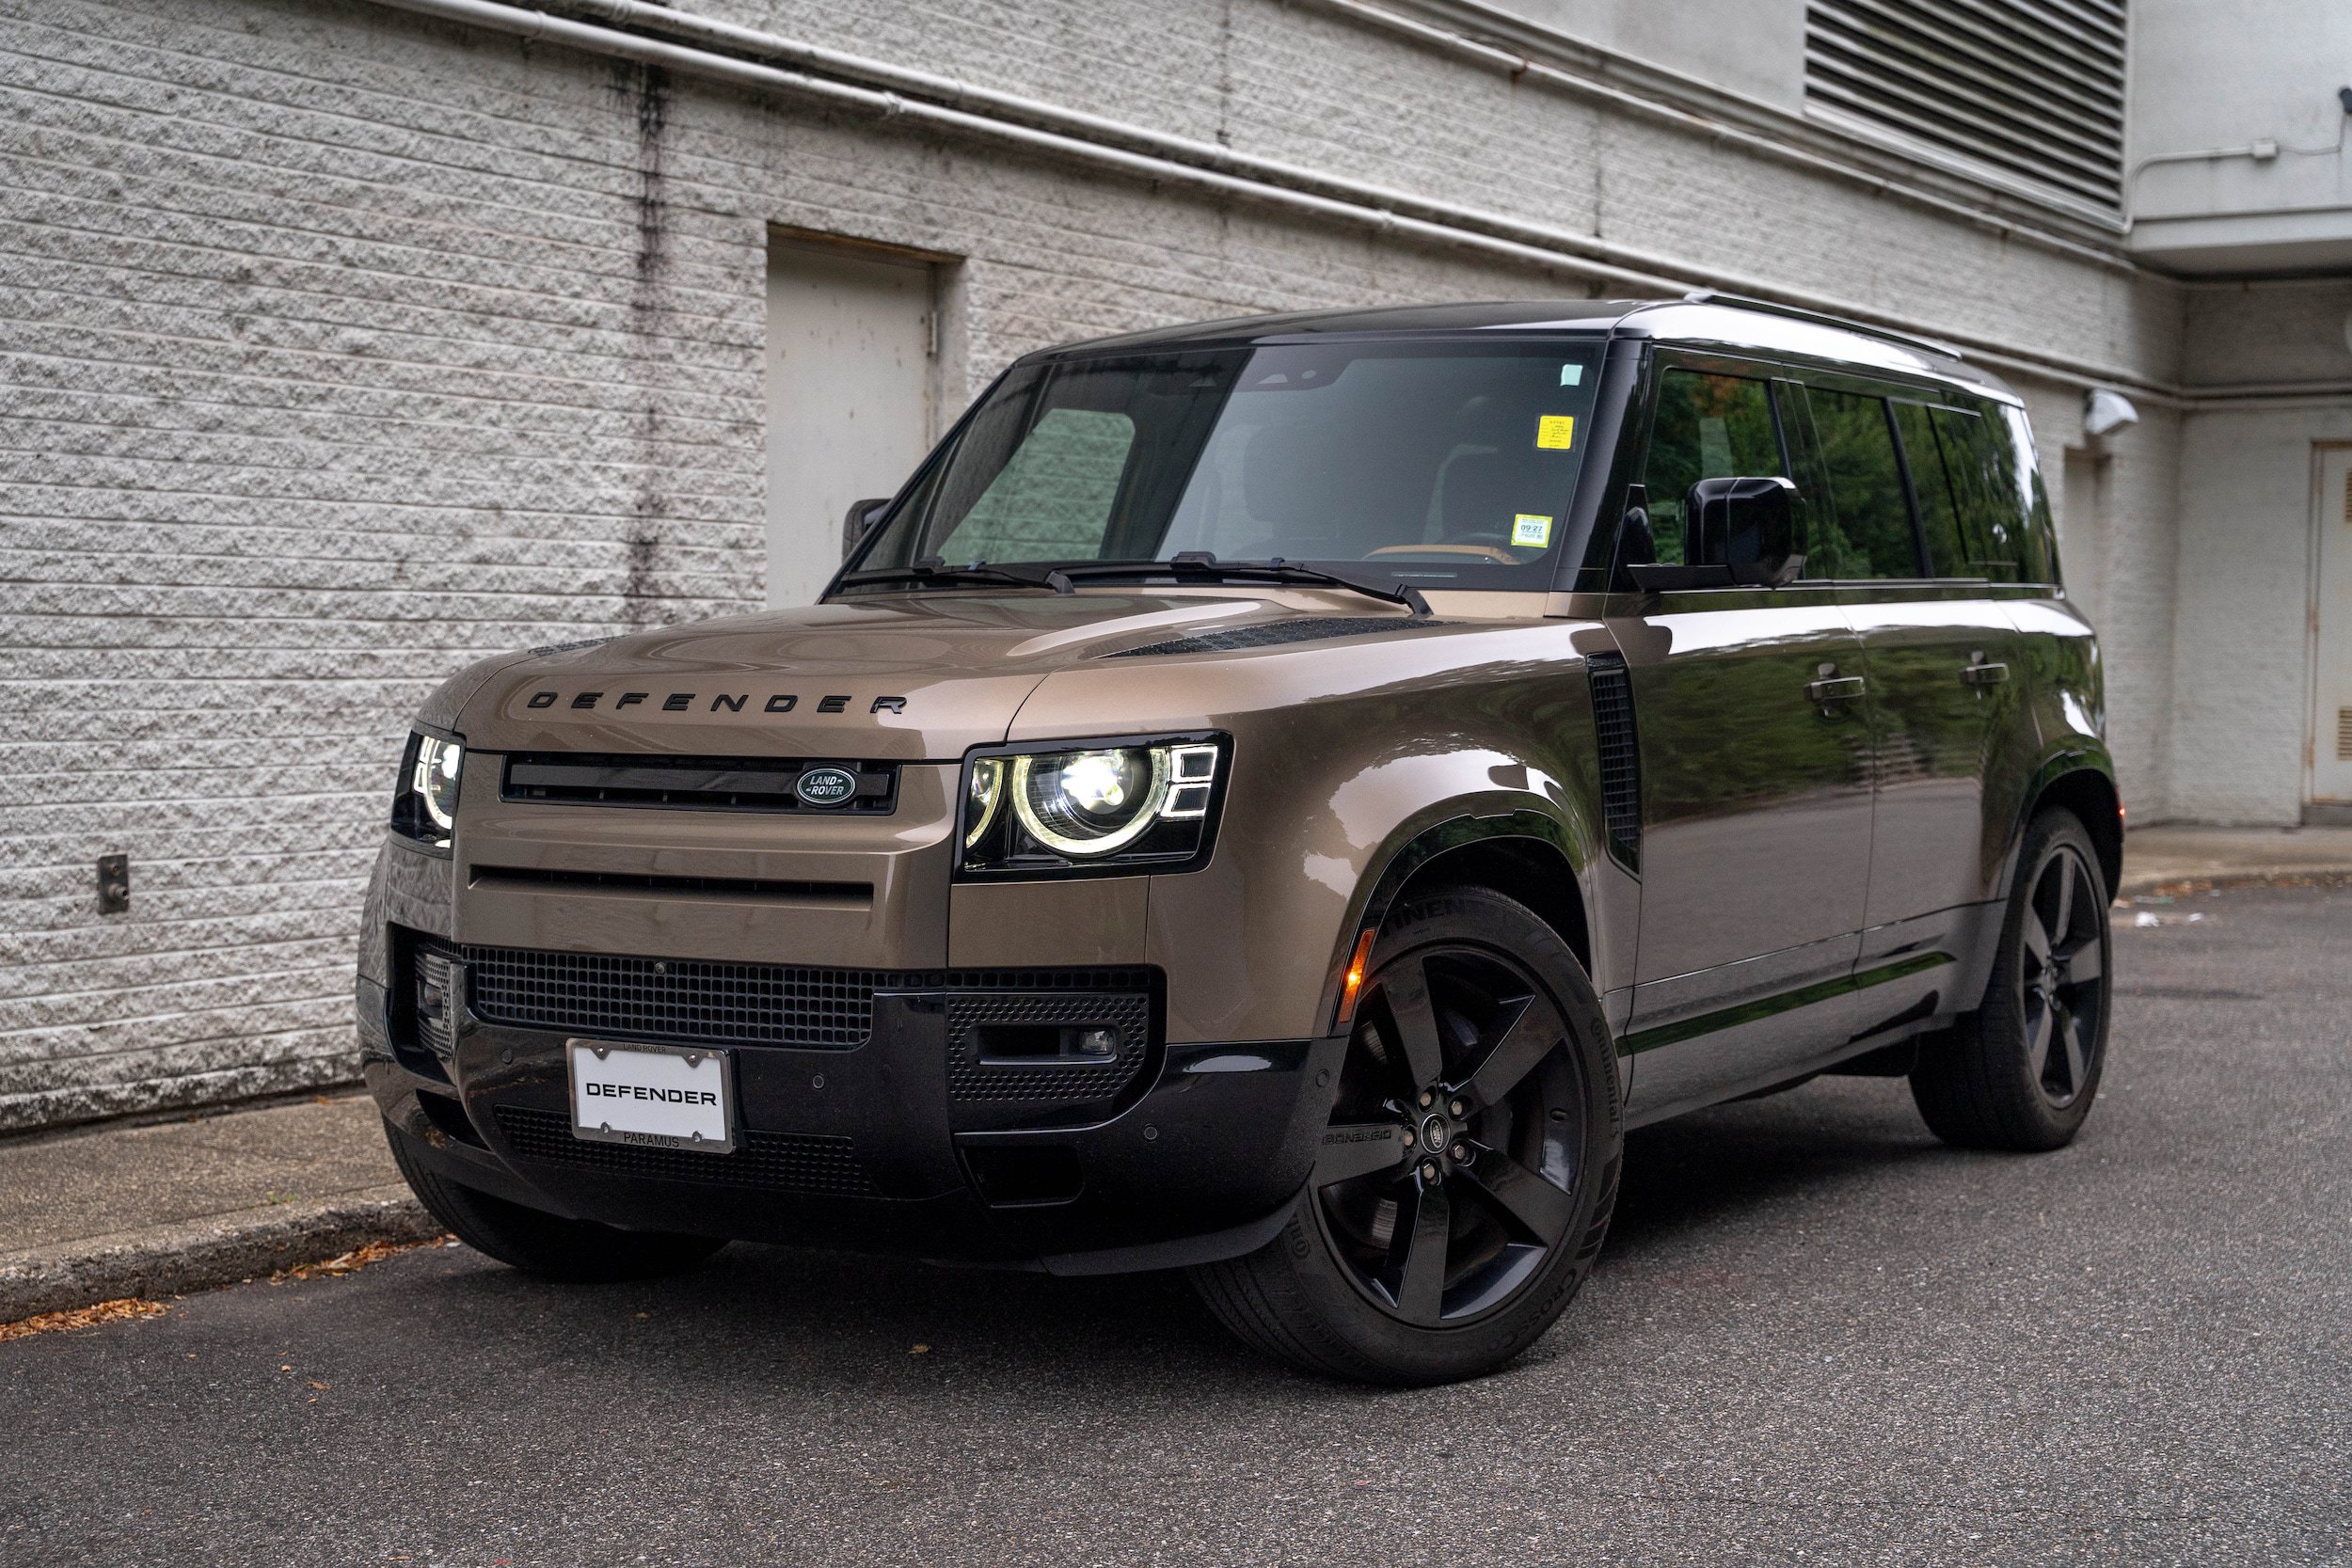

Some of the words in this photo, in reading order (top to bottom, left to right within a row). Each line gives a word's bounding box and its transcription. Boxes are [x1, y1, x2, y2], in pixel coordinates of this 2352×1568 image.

[527, 691, 908, 715] DEFENDER
[810, 776, 837, 785] LAND
[811, 785, 844, 795] ROVER
[623, 1043, 642, 1052] LAND
[643, 1045, 666, 1053] ROVER
[1591, 1017, 1620, 1123] Continental
[586, 1083, 717, 1106] DEFENDER
[624, 1132, 679, 1148] PARAMUS
